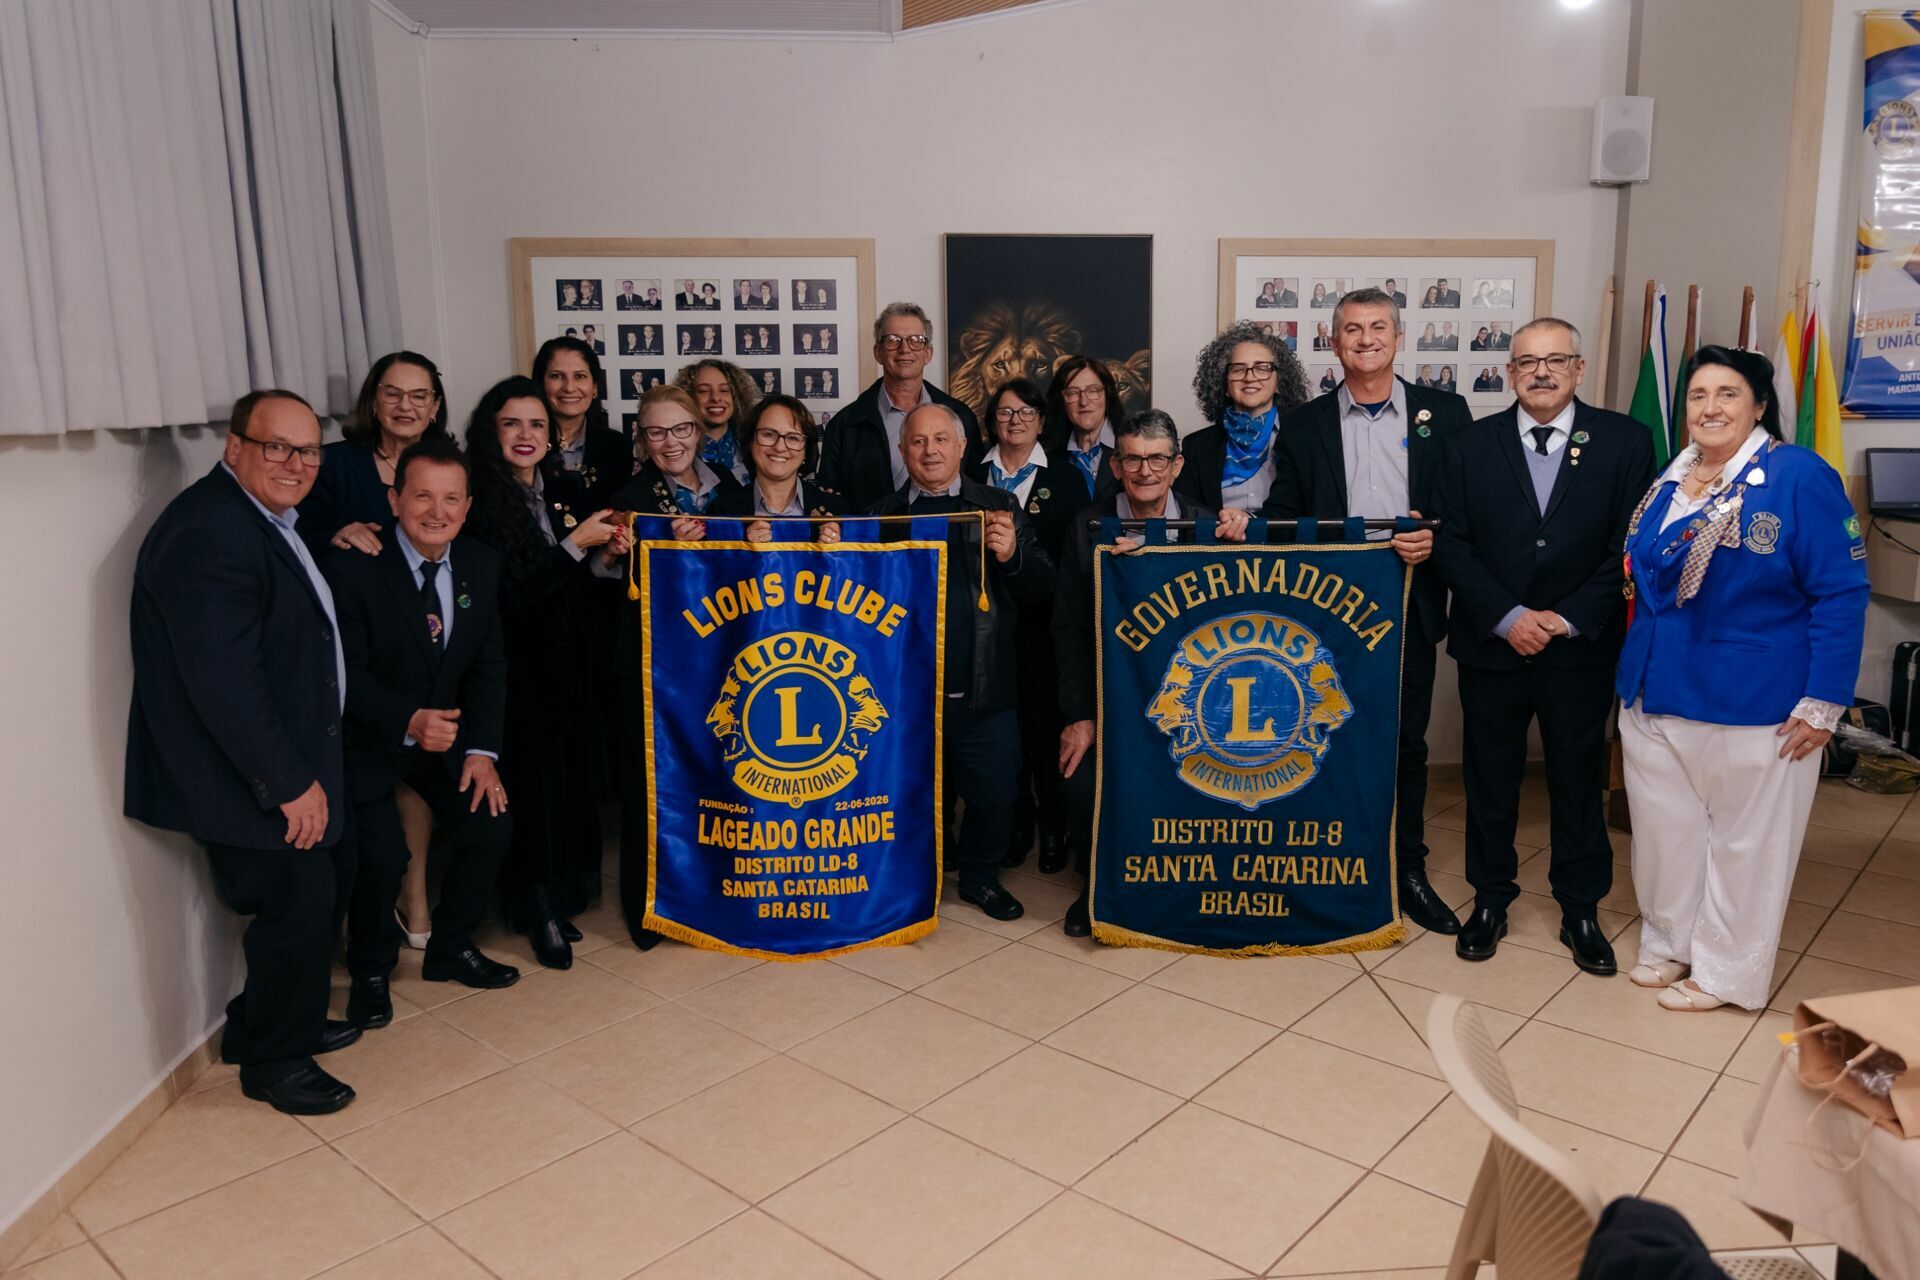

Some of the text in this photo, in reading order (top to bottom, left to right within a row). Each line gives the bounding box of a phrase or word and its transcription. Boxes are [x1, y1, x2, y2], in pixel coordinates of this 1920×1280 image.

[1857, 314, 1911, 334] SERVIR
[682, 570, 908, 639] LIONS CLUBE
[1115, 558, 1395, 653] GOVERNADORIA
[1192, 619, 1310, 661] LIONS
[740, 637, 850, 678] LIONS
[774, 686, 823, 747] L
[1225, 676, 1276, 742] L
[740, 763, 851, 796] INTERNATIONAL
[1189, 758, 1306, 793] INTERNATIONAL
[699, 799, 748, 814] FUNDAÇÃO
[835, 796, 890, 812] 22-06-2026
[697, 810, 896, 851] LAGEADO GRANDE
[1151, 817, 1344, 847] DISTRITO LD-8
[734, 852, 859, 875] DISTRITO LD-8
[1123, 853, 1369, 886] SANTA CATARINA
[722, 874, 869, 898] SANTA CATARINA
[757, 900, 831, 920] BRASIL
[1198, 890, 1290, 917] BRASIL
